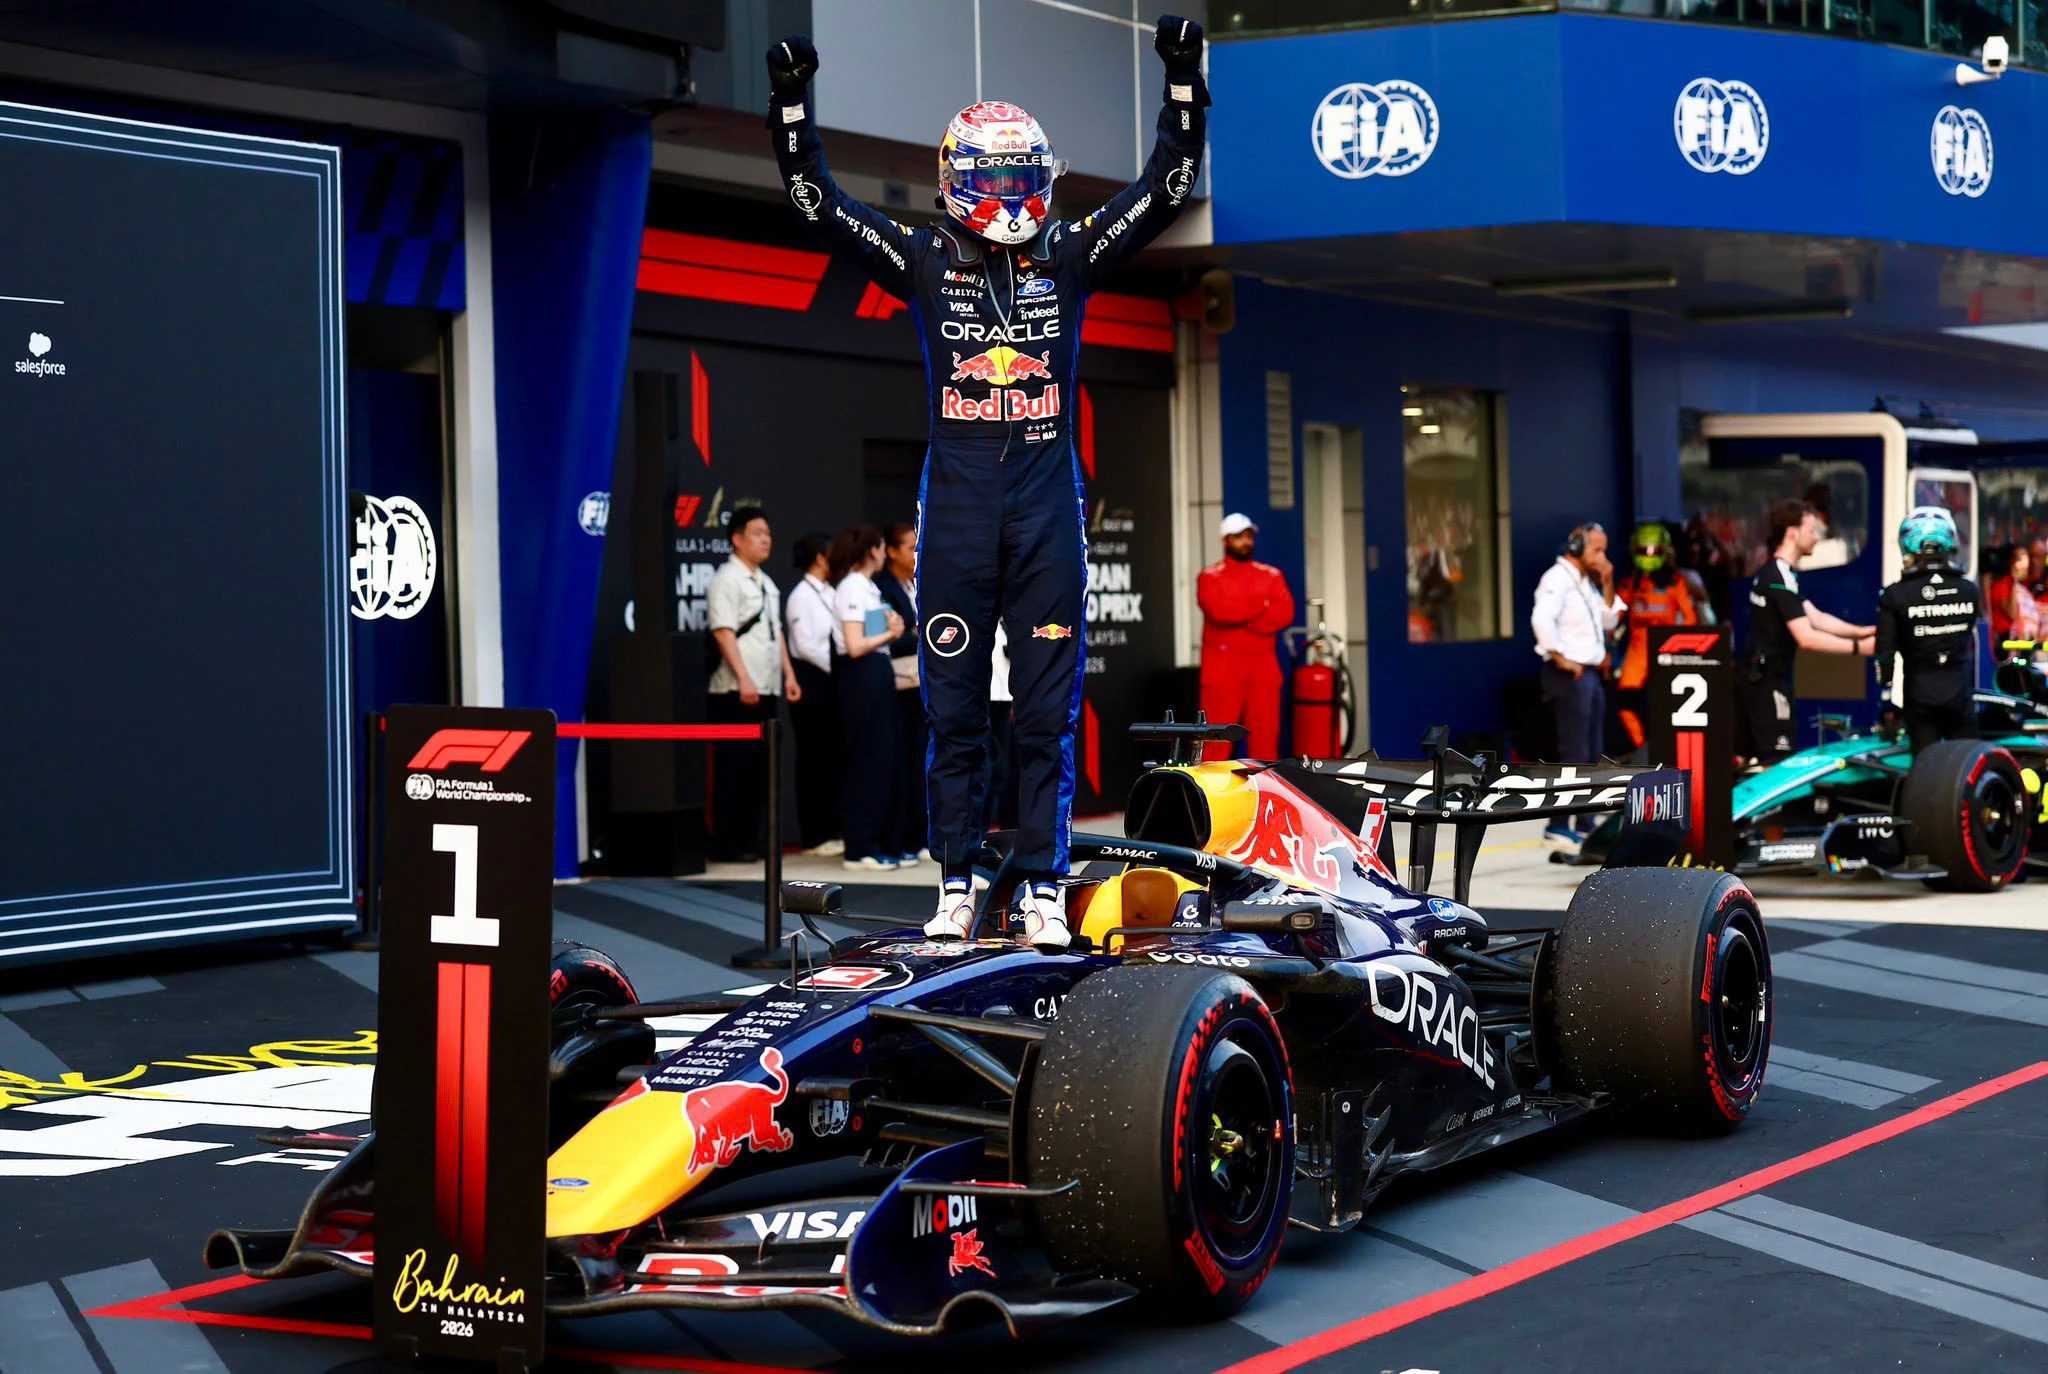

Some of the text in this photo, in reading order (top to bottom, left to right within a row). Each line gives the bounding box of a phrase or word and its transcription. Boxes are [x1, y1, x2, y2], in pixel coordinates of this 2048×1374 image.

[991, 140, 1028, 150] Red Bull
[976, 155, 1042, 168] ORACLE
[790, 173, 809, 198] Rock
[1169, 156, 1194, 206] Hard Rock
[800, 198, 819, 222] Hard
[1106, 217, 1128, 240] YOU
[1124, 192, 1152, 223] WINGS
[881, 239, 906, 271] WINGS
[943, 269, 977, 284] Mobil
[941, 287, 984, 299] CARLYLE
[948, 302, 975, 313] VISA
[1018, 304, 1060, 320] indeed
[941, 319, 1060, 343] ORACLE
[15, 358, 66, 378] salesforce
[942, 383, 1060, 421] Red Bull
[1042, 430, 1057, 441] MAX
[711, 538, 733, 553] GUL
[1087, 562, 1132, 592] RAIN
[1100, 593, 1144, 623] PRIX
[1908, 602, 1975, 619] PETRONAS
[1671, 673, 1708, 727] 2
[436, 779, 495, 792] FIA Formula 1
[436, 789, 462, 801] World
[1630, 784, 1671, 825] Mobil
[1099, 846, 1158, 860] DAMAC
[1192, 851, 1217, 871] VISA
[430, 823, 500, 947] 1
[765, 1001, 808, 1009] VISA
[752, 1019, 792, 1027] AT&T
[1365, 961, 1496, 1091] ORACLE
[717, 1030, 774, 1040] TRADE
[676, 1057, 731, 1068] neat.
[686, 1050, 747, 1060] CARLYLE
[650, 1075, 696, 1086] Mobil
[912, 1193, 978, 1239] Mobil
[393, 1248, 525, 1314] Bahrain
[420, 1301, 526, 1324] IN MALAYSIA
[440, 1319, 475, 1338] 2026
